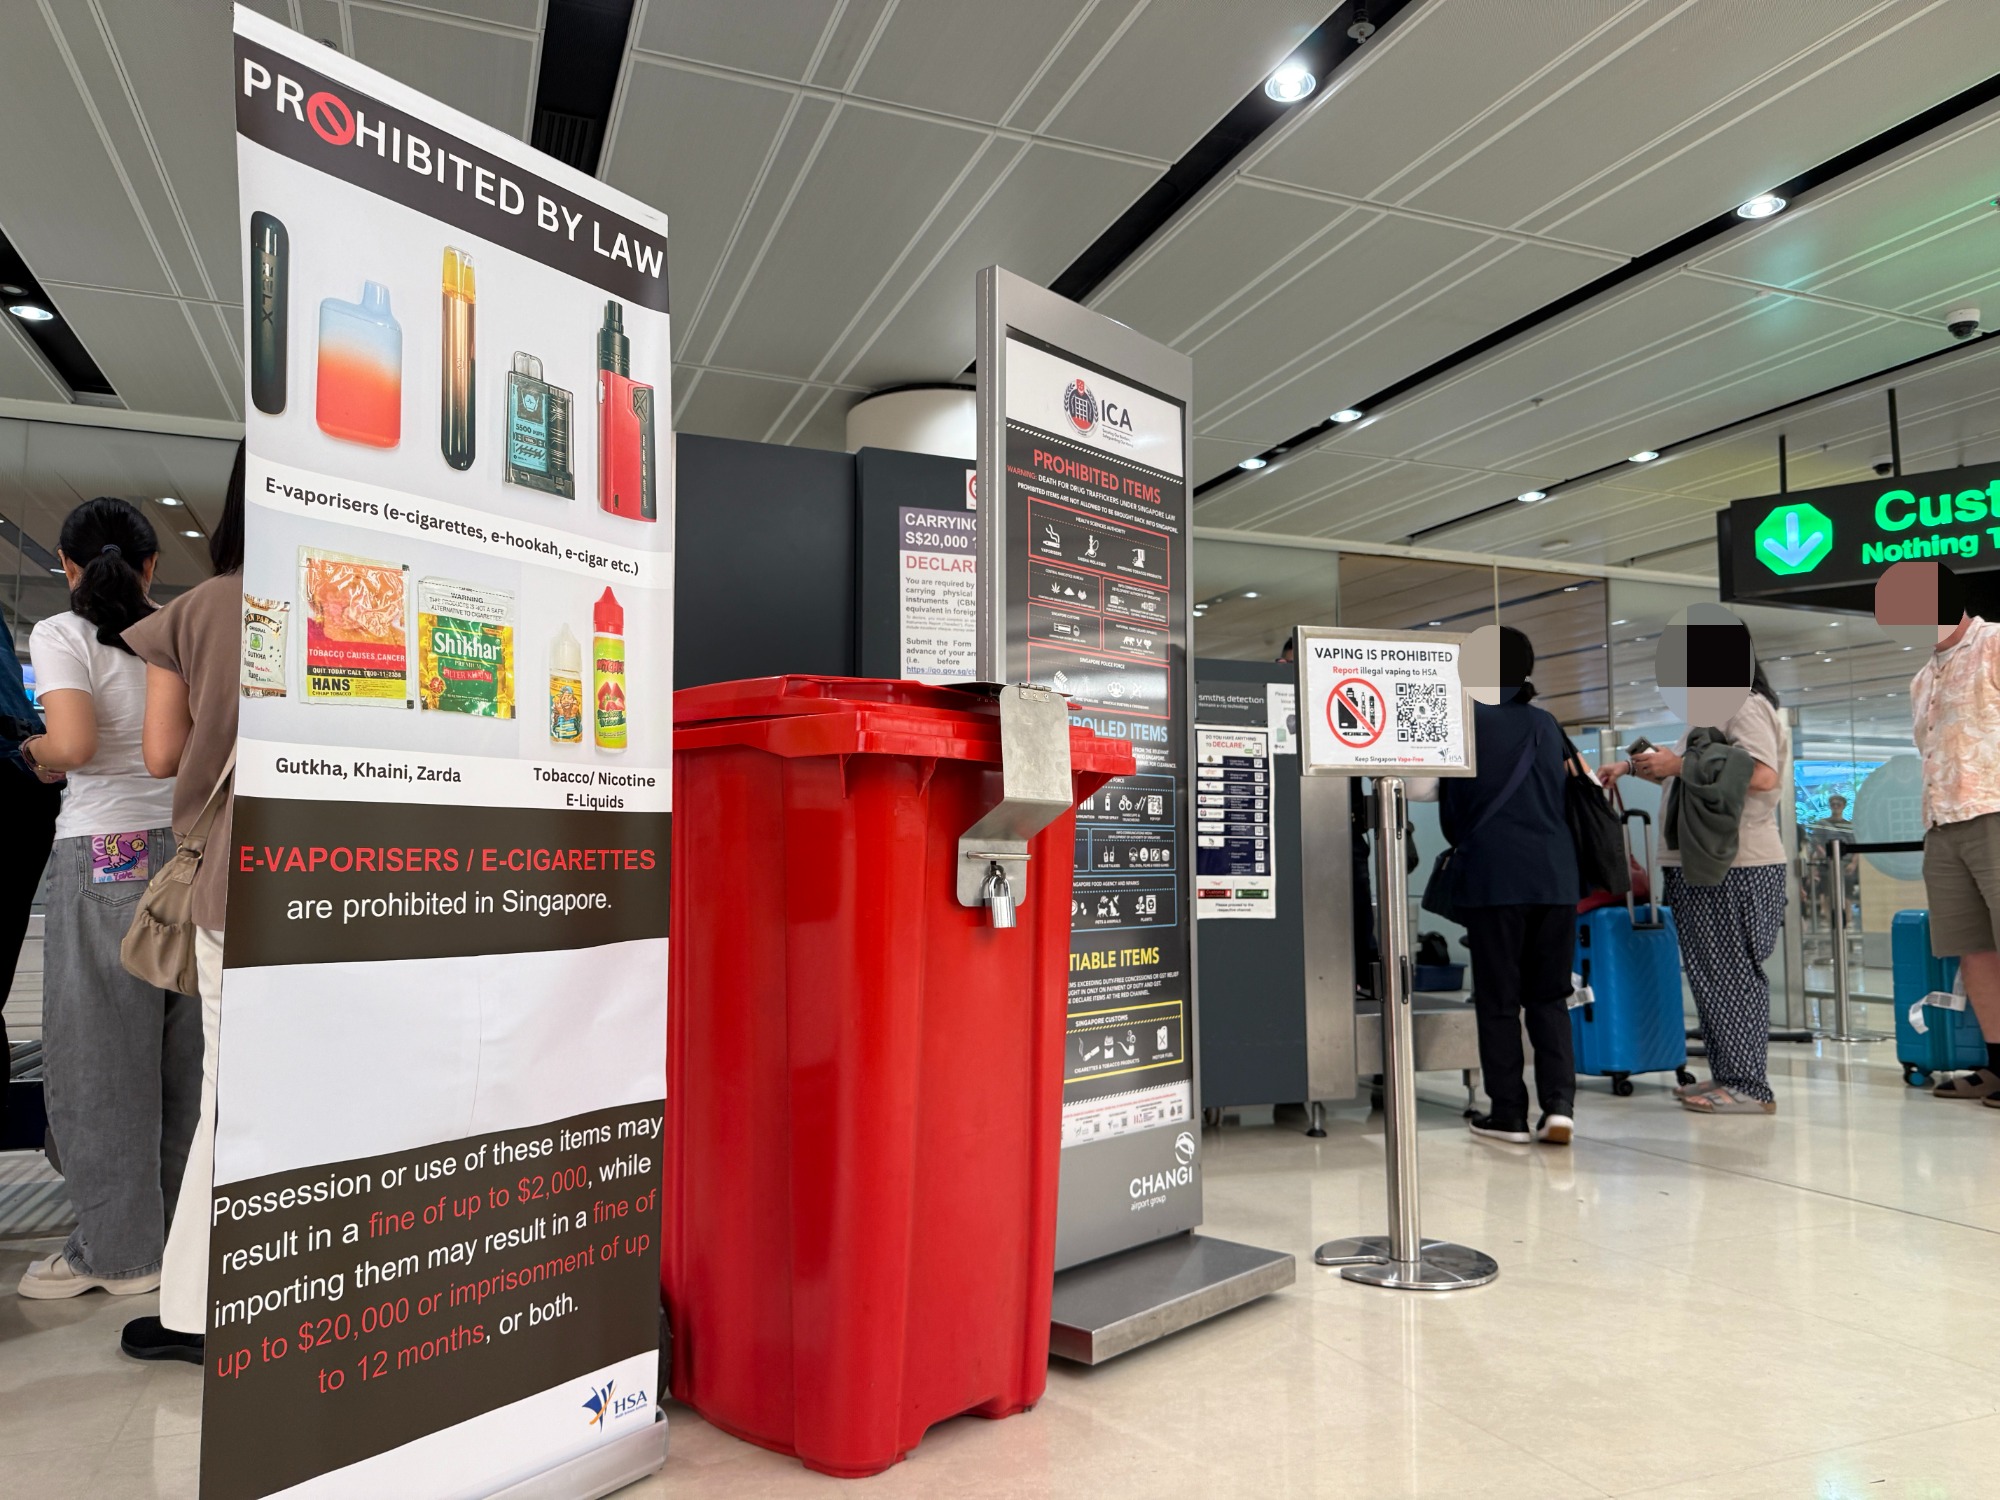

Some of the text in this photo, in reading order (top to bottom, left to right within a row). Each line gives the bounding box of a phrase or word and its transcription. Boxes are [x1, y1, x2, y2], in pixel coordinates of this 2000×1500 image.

[538, 195, 583, 241] BY
[594, 221, 663, 278] LAW
[1101, 399, 1132, 431] ICA
[1034, 449, 1161, 505] PROHIBITED ITEMS
[1006, 464, 1165, 519] WARNING: DEATH FOR DRUG TRAFFICKERS UNDER SINGAPORE
[1017, 481, 1045, 495] PROHIBITED
[1046, 490, 1060, 500] ITEMS
[266, 476, 639, 576] E-vaporisers (e-cigarettes, e-hookah, e-cigar etc.)
[905, 531, 968, 549] S$20,000
[1862, 533, 1979, 565] Nothing
[906, 555, 976, 574] DECLAR
[905, 576, 919, 585] You
[934, 579, 964, 588] required
[966, 581, 975, 589] by
[451, 592, 484, 604] WARNING
[905, 587, 973, 598] carrying physical
[905, 596, 949, 605] instruments
[905, 605, 943, 614] equivalent
[434, 631, 501, 661] Shikhar
[906, 637, 972, 648] Submit the Form
[309, 648, 405, 662] TOBACCO CAUSES CANCER
[906, 647, 965, 658] advance of your
[937, 657, 960, 666] before
[1314, 647, 1453, 662] VAPING IS PROHIBITED
[1332, 666, 1359, 675] Report
[1360, 667, 1384, 676] illegal
[1385, 667, 1411, 677] vaping
[1412, 668, 1421, 676] to
[312, 677, 350, 691] HANS
[1198, 694, 1226, 702] smiths
[1226, 695, 1264, 704] detection
[1130, 722, 1168, 743] ITEMS
[1354, 756, 1369, 764] Keep
[1370, 756, 1397, 764] Singapore
[275, 757, 462, 783] Gutkha, Khaini, Zarda
[533, 767, 656, 787] Tobacco/ Nicotine
[566, 793, 624, 811] E-Liquids
[239, 846, 459, 873] E-VAPORISERS
[482, 848, 656, 872] E-CIGARETTES
[287, 890, 612, 925] are prohibited in Singapore.
[1120, 946, 1160, 967] ITEMS
[1077, 979, 1102, 988] EXCEEDING
[1075, 1014, 1128, 1027] SINGAPORE CUSTOMS
[1074, 1064, 1099, 1074] CIGARETTES
[212, 1116, 664, 1227] Possession or use of these items may
[1129, 1166, 1193, 1198] CHANGI
[1130, 1194, 1167, 1211] airport group
[222, 1154, 651, 1275] result in a fine of up to $2,000, while
[215, 1188, 657, 1328] importing them may result in a fine of
[217, 1233, 650, 1379] up to $20,000 or imprisonment of up
[318, 1291, 579, 1394] to 12 months, or both.
[614, 1390, 648, 1415] HSA
